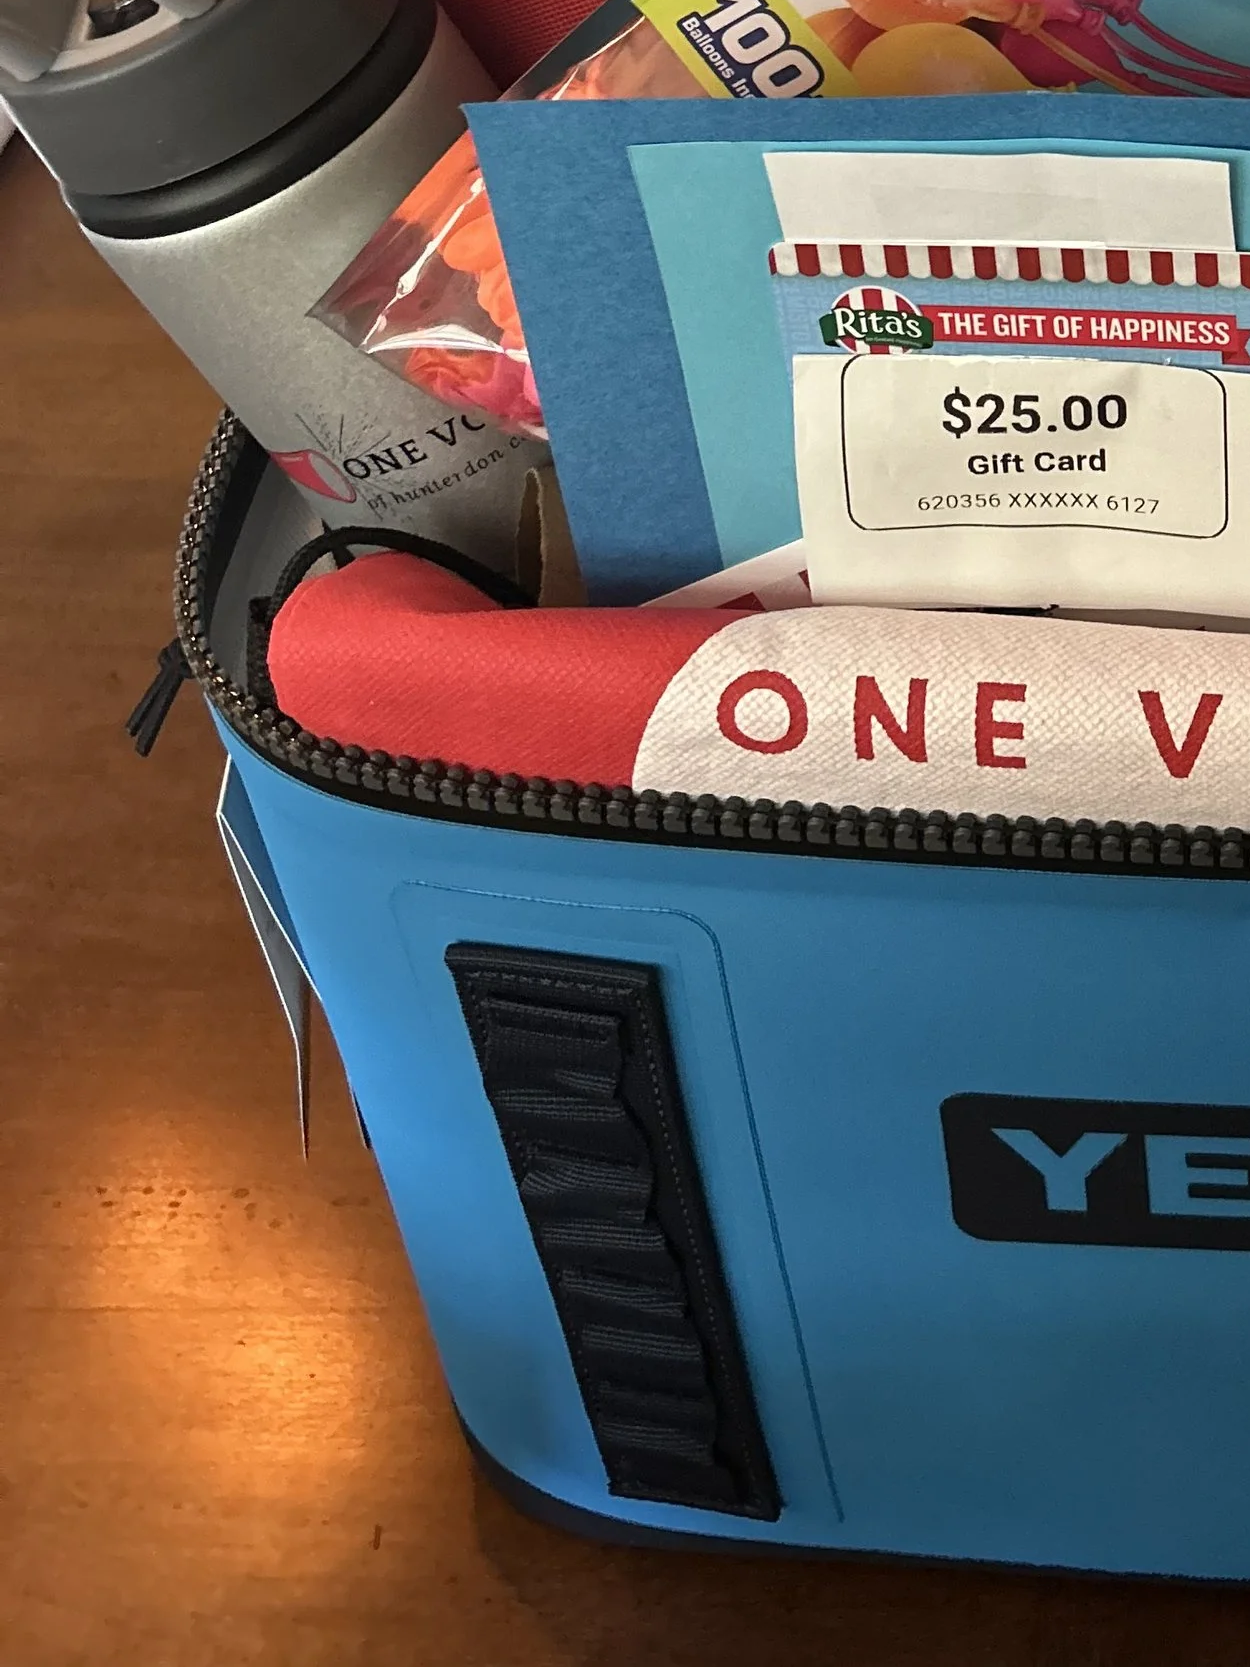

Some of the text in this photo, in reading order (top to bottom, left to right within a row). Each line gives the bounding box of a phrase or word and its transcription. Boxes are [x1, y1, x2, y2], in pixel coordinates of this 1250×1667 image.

[682, 16, 736, 79] Balloons
[834, 307, 1231, 347] Rita's THE GIFT OF HAPPINESS
[942, 386, 1128, 439] $25.00
[343, 438, 429, 481] ONE
[390, 448, 504, 505] hunterdon
[967, 448, 1107, 475] Gift Card
[917, 492, 1160, 516] 620356 XXXXXX 6127
[717, 669, 1030, 771] ONE
